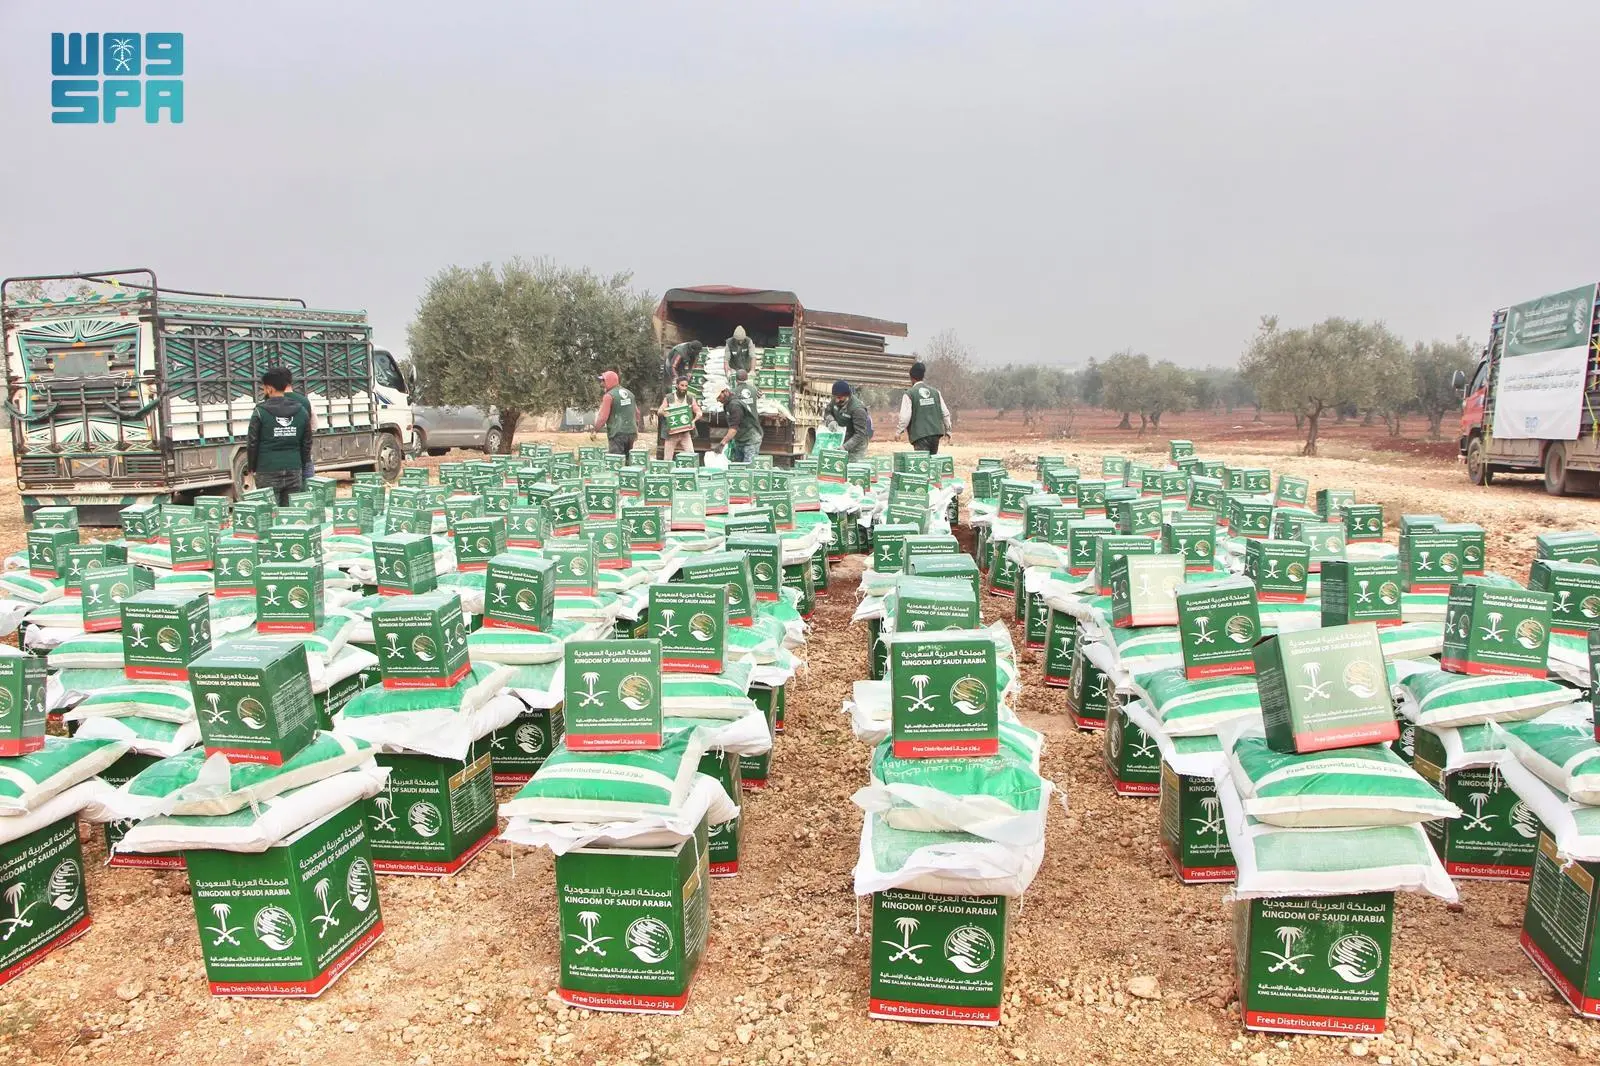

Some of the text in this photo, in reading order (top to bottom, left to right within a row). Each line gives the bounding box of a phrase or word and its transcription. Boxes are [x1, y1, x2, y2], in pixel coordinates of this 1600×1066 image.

[1189, 785, 1217, 793] KINGDO
[27, 859, 37, 869] OF
[38, 847, 58, 863] SAUDI
[58, 833, 77, 852] ARABIA
[302, 862, 328, 882] KINGDOM
[1471, 866, 1509, 875] Distributed
[196, 878, 289, 888] المملكة العربية السعودية
[243, 889, 264, 897] SAUDI
[564, 884, 672, 898] المملكة العربية السعودية
[564, 896, 672, 907] KINGDOM OF SAUDI ARABIA
[882, 901, 997, 915] KINGDOM OF SAUDI ARABIA
[1262, 898, 1386, 913] المملكة العربية السعودية
[1262, 910, 1385, 923] KINGDOM OF SAUDI ARABIA
[572, 994, 633, 1005] Free Distributed
[880, 1003, 945, 1016] Free Distributed
[1257, 1015, 1327, 1028] Free Distributed
